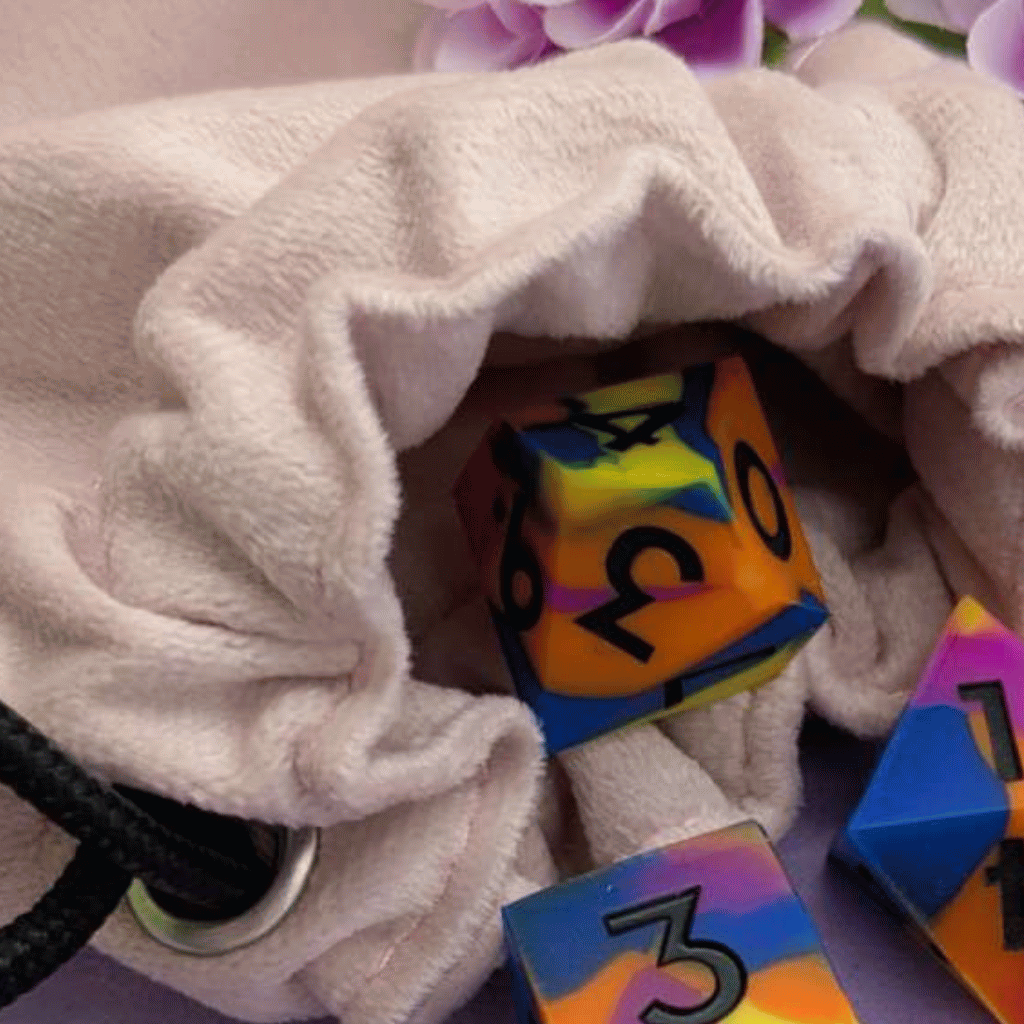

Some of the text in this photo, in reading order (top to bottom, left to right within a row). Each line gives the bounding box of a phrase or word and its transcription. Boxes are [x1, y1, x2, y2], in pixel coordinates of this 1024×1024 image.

[733, 438, 792, 562] 0
[573, 525, 705, 664] 3
[957, 679, 1024, 783] 1
